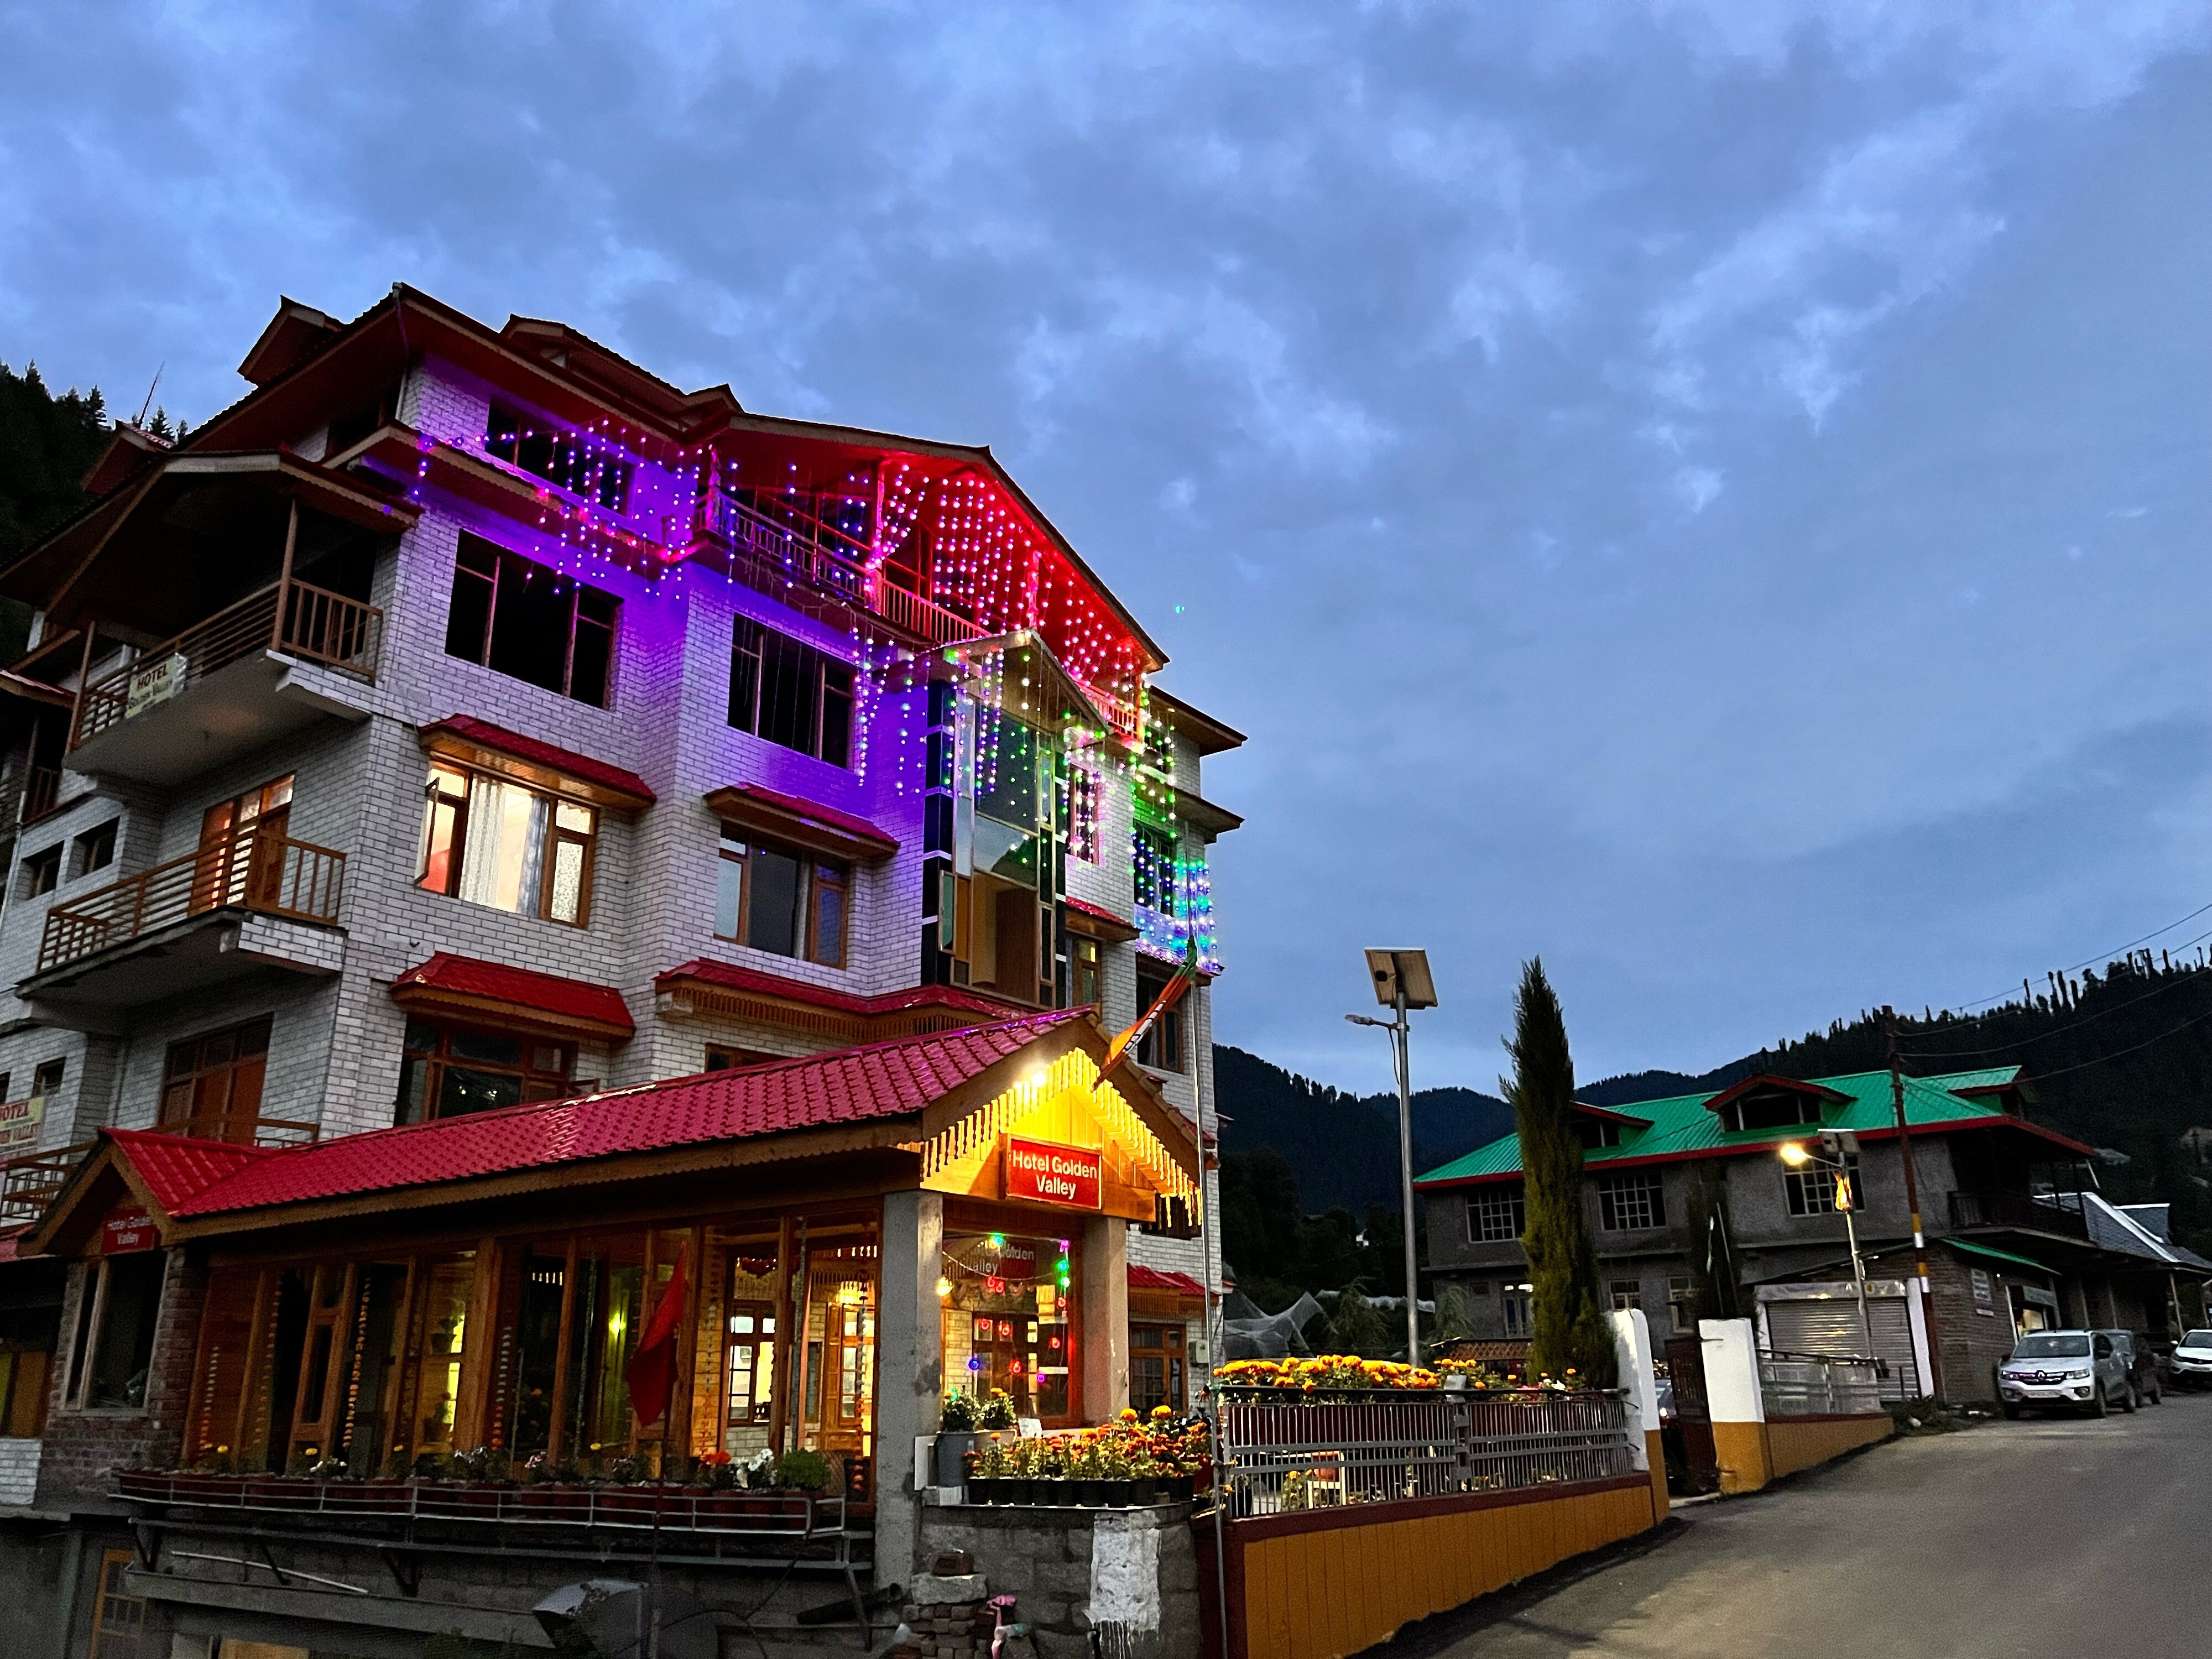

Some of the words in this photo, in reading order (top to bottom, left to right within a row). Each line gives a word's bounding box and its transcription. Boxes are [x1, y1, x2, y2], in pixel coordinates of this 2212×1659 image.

[137, 663, 168, 691] HOTEL
[1013, 1150, 1050, 1172] Hotel
[1051, 1156, 1097, 1179] Golden
[1036, 1173, 1076, 1200] Valley
